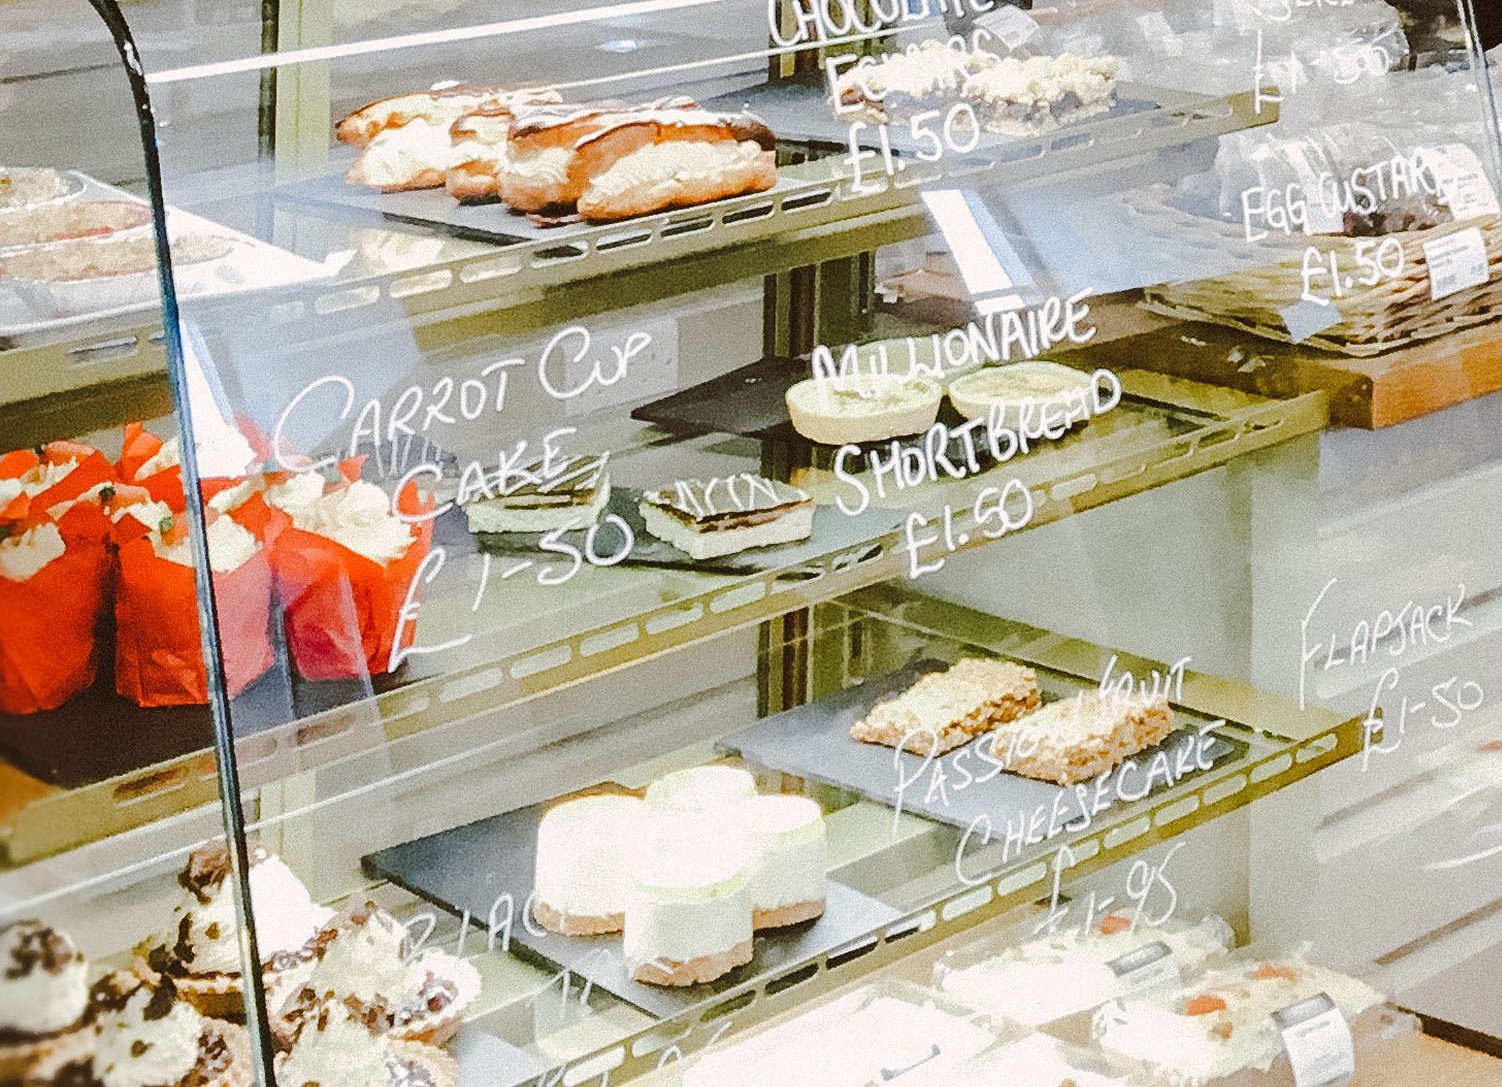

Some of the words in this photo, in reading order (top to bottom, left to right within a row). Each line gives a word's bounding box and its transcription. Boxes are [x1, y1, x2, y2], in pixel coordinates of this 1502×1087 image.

[843, 102, 980, 194] £1.50
[1241, 186, 1313, 244] EGG
[1300, 236, 1405, 306] £1.50
[273, 358, 526, 473] CARROT
[833, 367, 1122, 517] SHORTBREAD
[392, 427, 577, 523] CAKE
[904, 479, 1034, 580] £1.50
[1299, 577, 1474, 712] FLAPJACK
[954, 719, 1227, 888] CHEESECAKE
